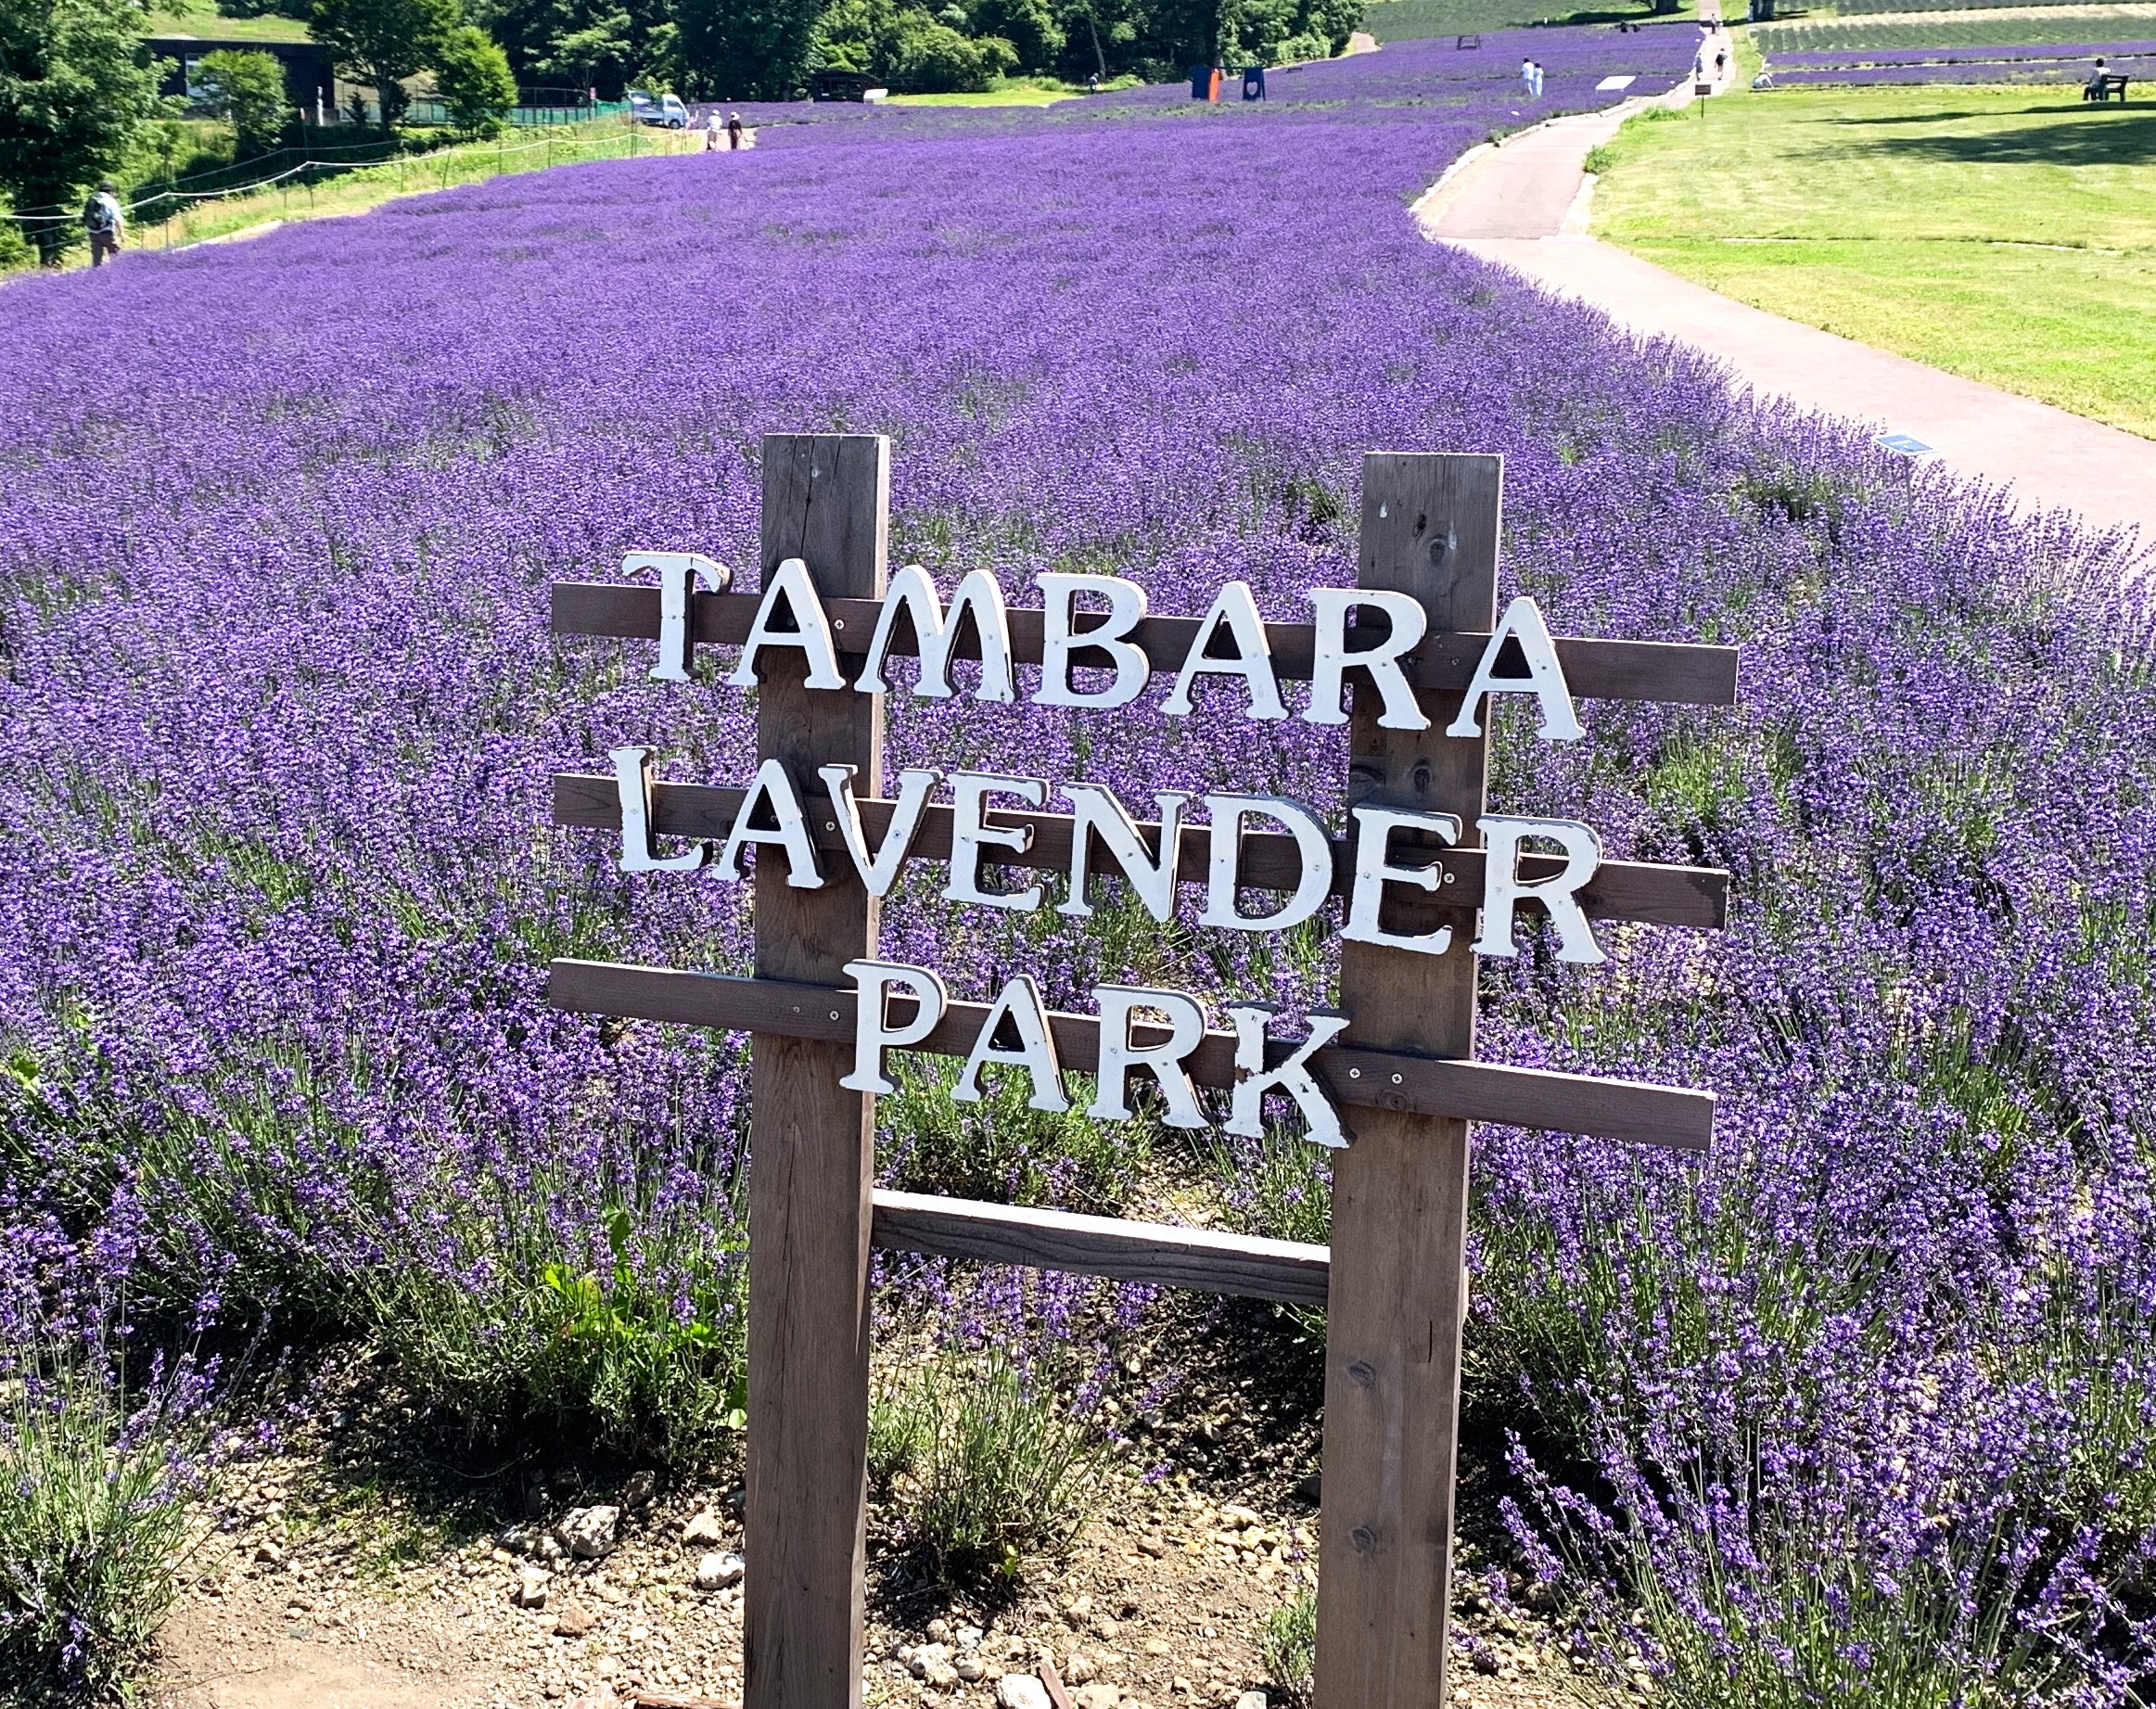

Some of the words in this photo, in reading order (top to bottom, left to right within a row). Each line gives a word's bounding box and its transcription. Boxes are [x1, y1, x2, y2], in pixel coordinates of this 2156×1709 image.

[622, 553, 1585, 740] TAMBARA
[610, 746, 1607, 963] LAVENDER
[839, 959, 1351, 1149] PARK
